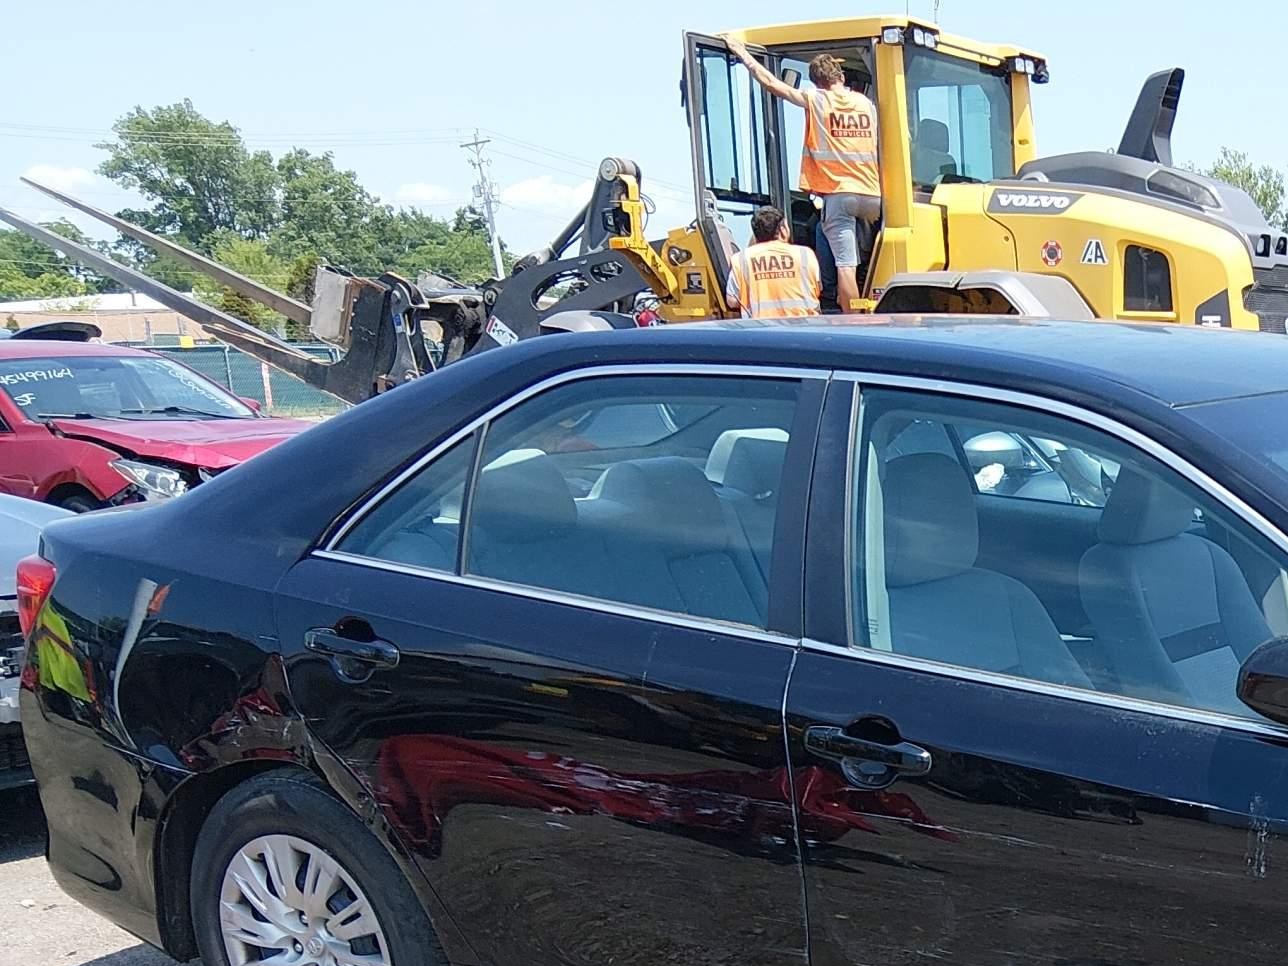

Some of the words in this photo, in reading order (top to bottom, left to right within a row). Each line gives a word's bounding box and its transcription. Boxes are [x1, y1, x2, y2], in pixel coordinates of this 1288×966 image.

[830, 112, 871, 129] MAD
[997, 194, 1070, 208] VOLVO
[751, 255, 794, 273] MAD
[0, 368, 74, 385] 45499164
